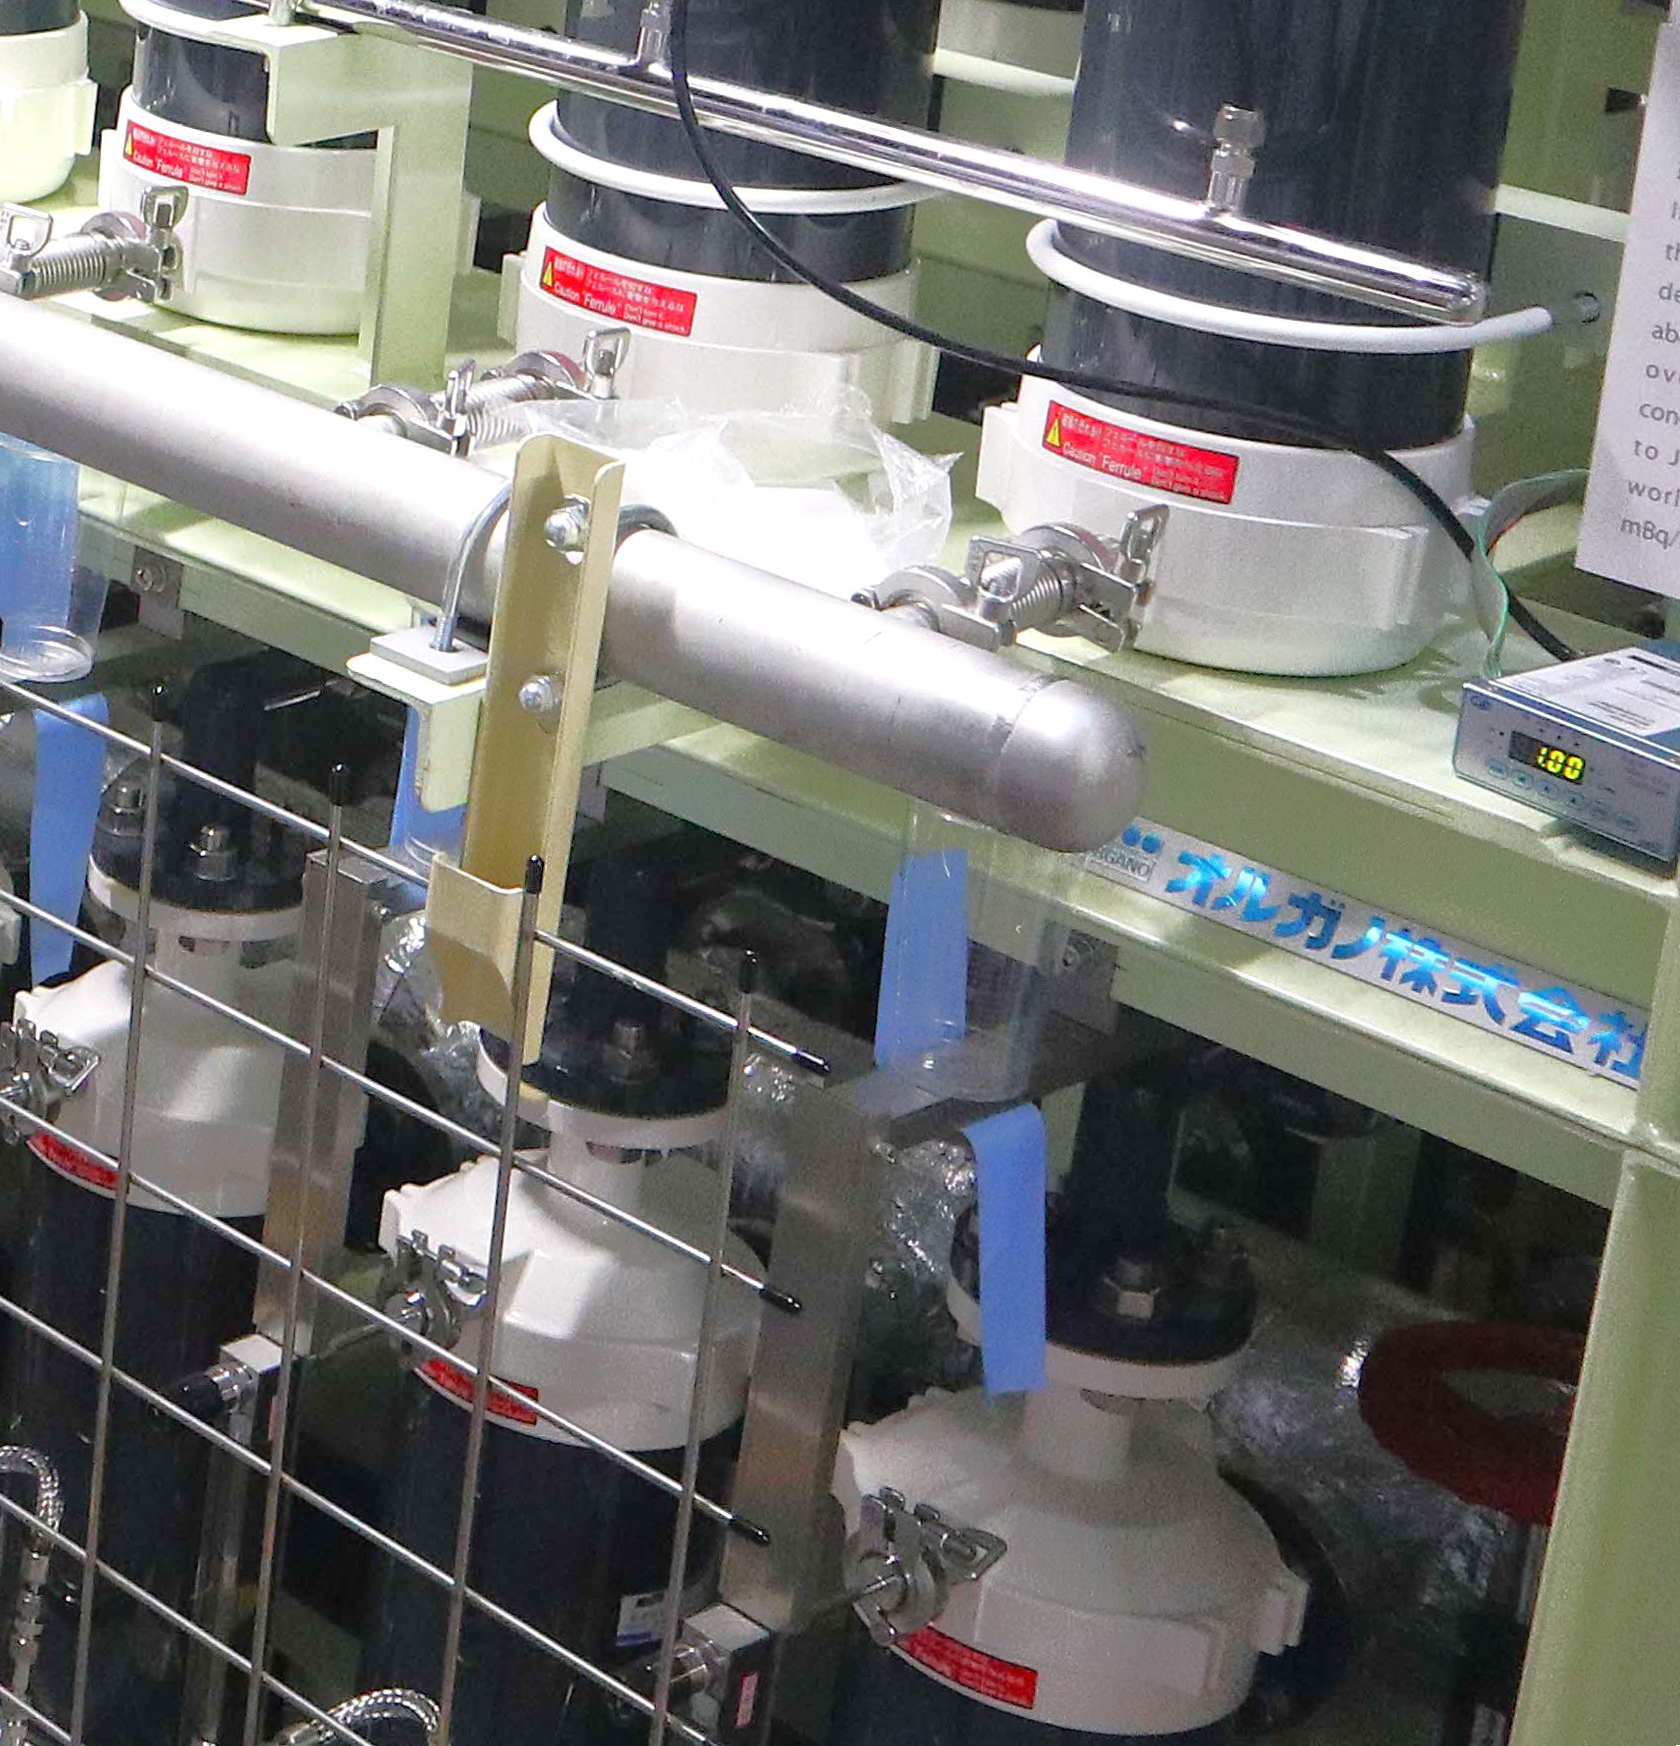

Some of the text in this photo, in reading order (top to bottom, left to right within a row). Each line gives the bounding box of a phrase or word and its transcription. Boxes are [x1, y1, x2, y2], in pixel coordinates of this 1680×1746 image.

[553, 281, 622, 315] Caution "Ferrule"
[1651, 322, 1680, 345] ab
[1645, 364, 1680, 383] ov
[1638, 403, 1680, 426] con
[1063, 441, 1148, 480] Caution "Ferrule"
[1633, 440, 1659, 461] to
[1619, 518, 1680, 551] mBq/
[1536, 744, 1586, 782] 1.00
[1091, 848, 1151, 877] GANO
[1163, 849, 1648, 1080] オルガノ株式会社
